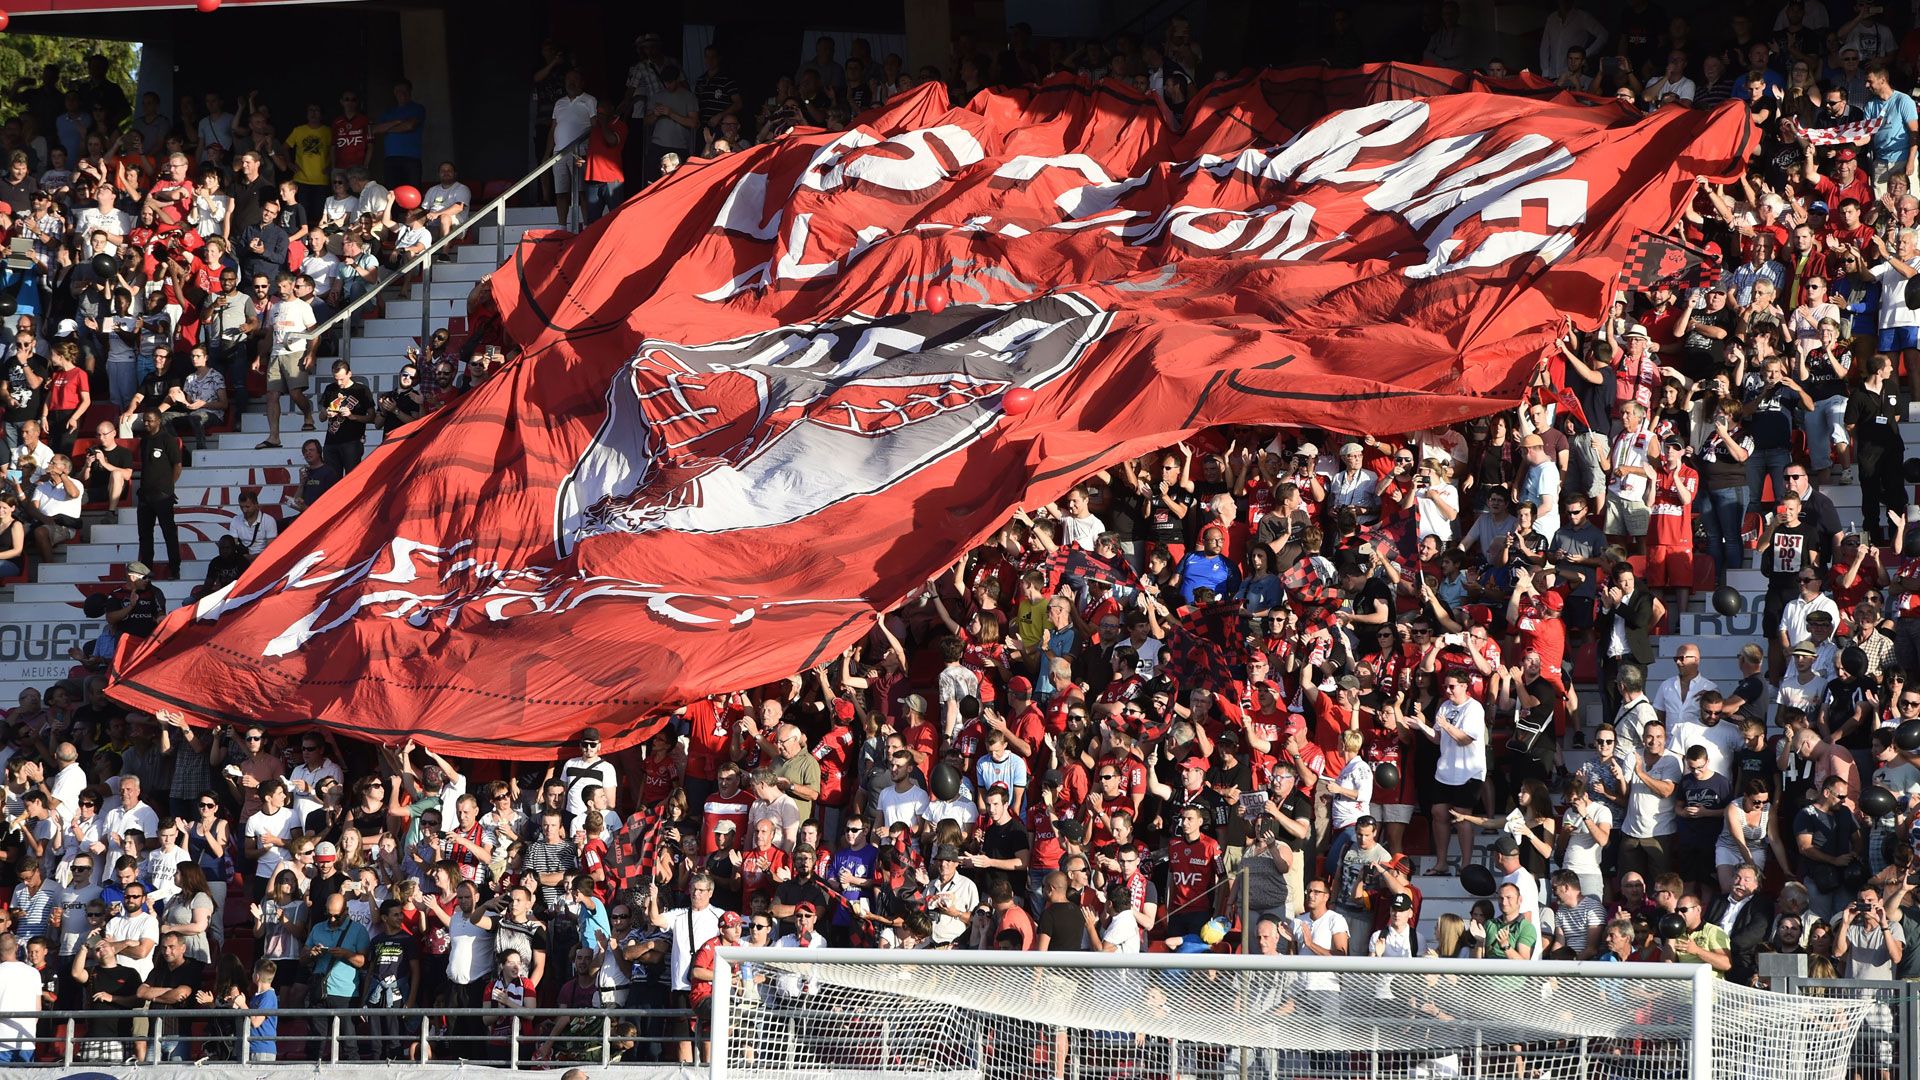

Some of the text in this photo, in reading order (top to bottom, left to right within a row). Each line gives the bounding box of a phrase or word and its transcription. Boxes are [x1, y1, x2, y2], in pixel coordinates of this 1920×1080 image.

[336, 136, 363, 149] DVF
[1775, 535, 1801, 547] JUST
[1779, 548, 1795, 558] DO
[1782, 559, 1794, 570] IT.
[22, 667, 70, 679] MEURSA
[1173, 872, 1202, 886] DVF
